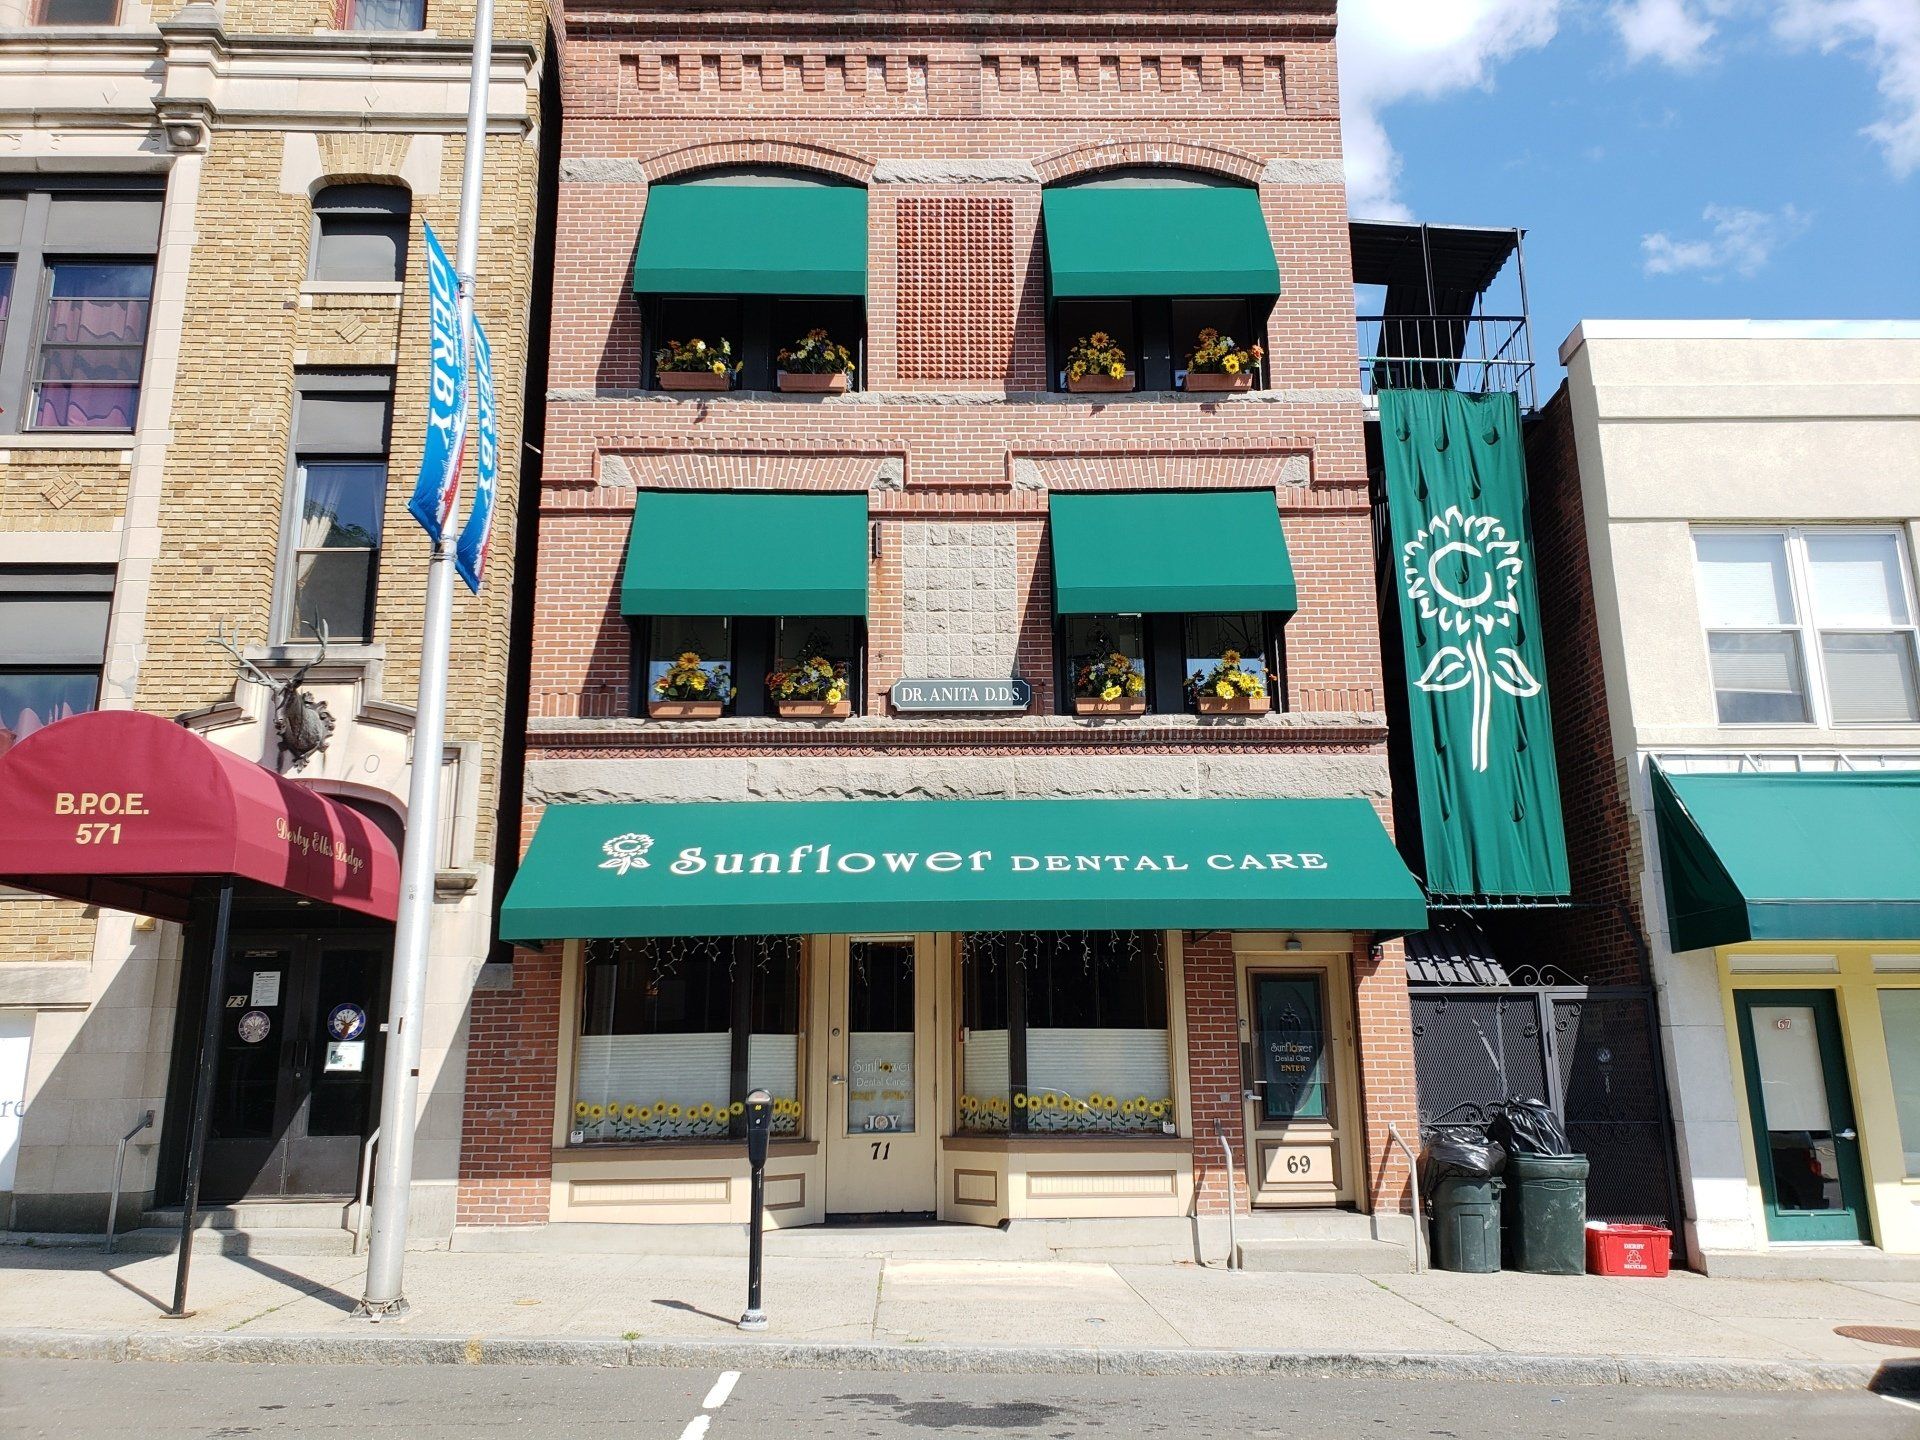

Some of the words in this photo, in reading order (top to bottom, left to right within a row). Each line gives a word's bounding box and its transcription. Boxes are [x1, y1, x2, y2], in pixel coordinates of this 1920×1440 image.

[428, 242, 455, 450] DERBY
[473, 322, 495, 509] DERBY
[901, 687, 927, 702] DR.
[930, 687, 979, 702] ANITA
[984, 687, 1023, 702] D.D.S.
[55, 792, 150, 815] B.P.O.E.
[75, 823, 122, 845] 571
[276, 817, 310, 856] Derby
[311, 831, 334, 858] Elks
[335, 841, 364, 875] Lodge
[669, 844, 993, 876] Sunflower
[1010, 855, 1189, 872] DENTAL
[1206, 853, 1328, 870] CARE
[228, 997, 246, 1007] 73
[1777, 1018, 1792, 1030] 67
[1270, 1041, 1313, 1053] Sunflower
[852, 1058, 911, 1074] Sunflower
[1280, 1064, 1307, 1072] ENTER
[856, 1077, 884, 1088] Dental
[885, 1077, 906, 1087] Care
[864, 1115, 900, 1130] JOY
[870, 1141, 890, 1160] 71
[1287, 1155, 1311, 1174] 69
